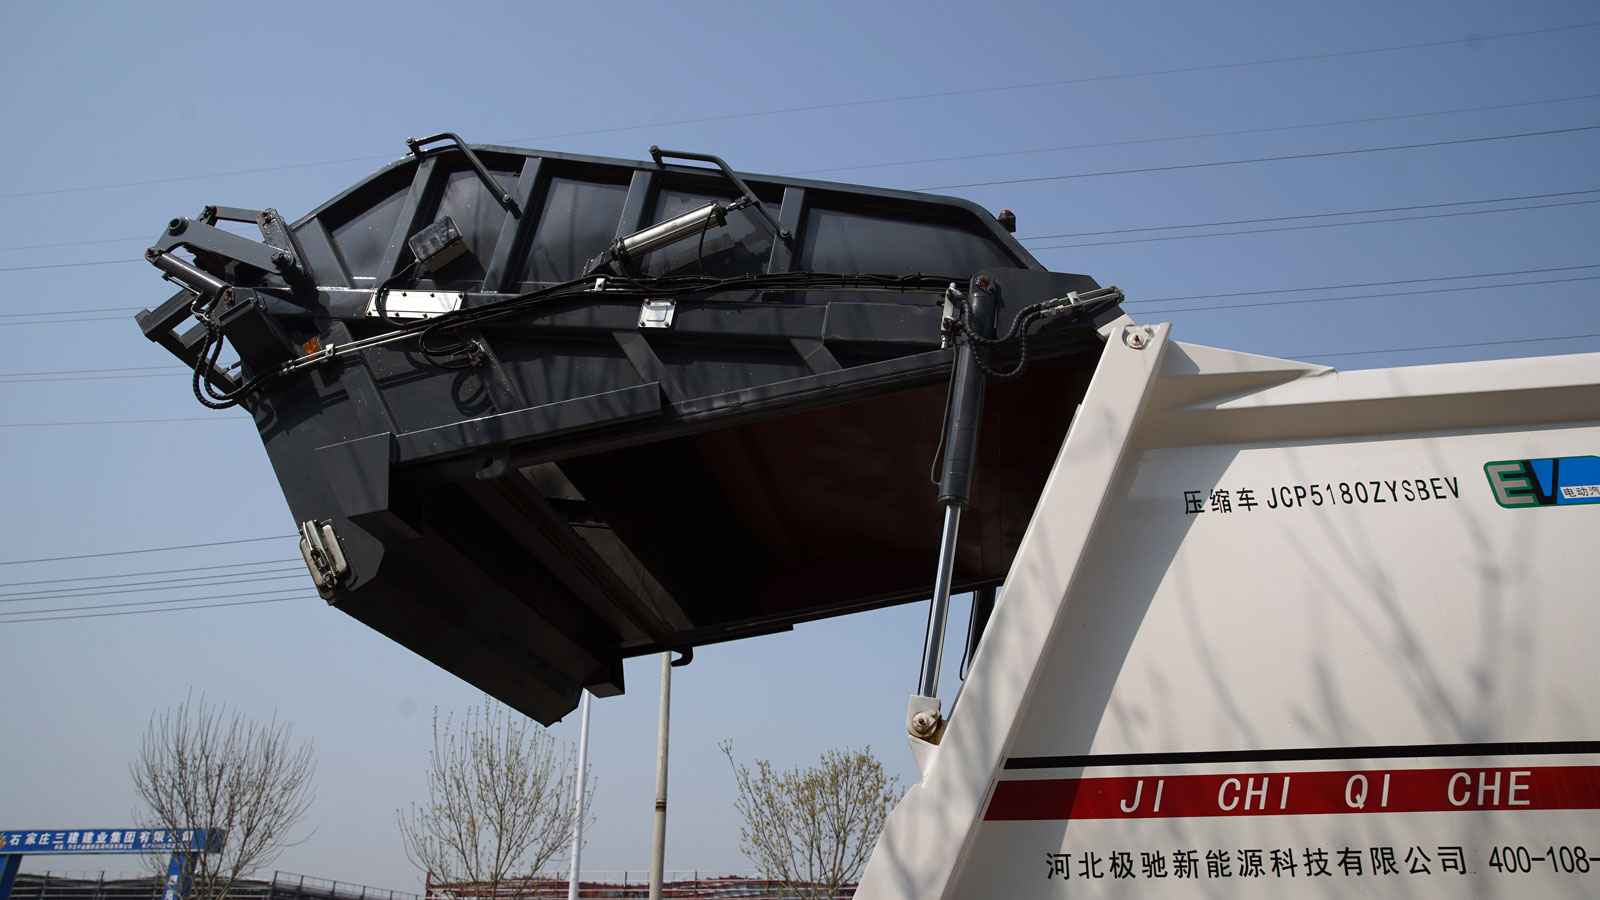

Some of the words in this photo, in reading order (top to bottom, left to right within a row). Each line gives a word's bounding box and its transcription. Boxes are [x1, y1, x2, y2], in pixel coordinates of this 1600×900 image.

[1184, 488, 1258, 516] 压缩车
[1267, 476, 1460, 509] JCP5180ZYSBEV
[1485, 458, 1560, 507] EV
[1120, 780, 1165, 812] JI
[1217, 776, 1291, 810] CHI
[1344, 774, 1392, 809] QI
[1447, 771, 1532, 806] CHE
[9, 831, 194, 846] 石家庄三建建业集团有限公司
[1046, 846, 1467, 881] 河北极驰新能源科技有限公司
